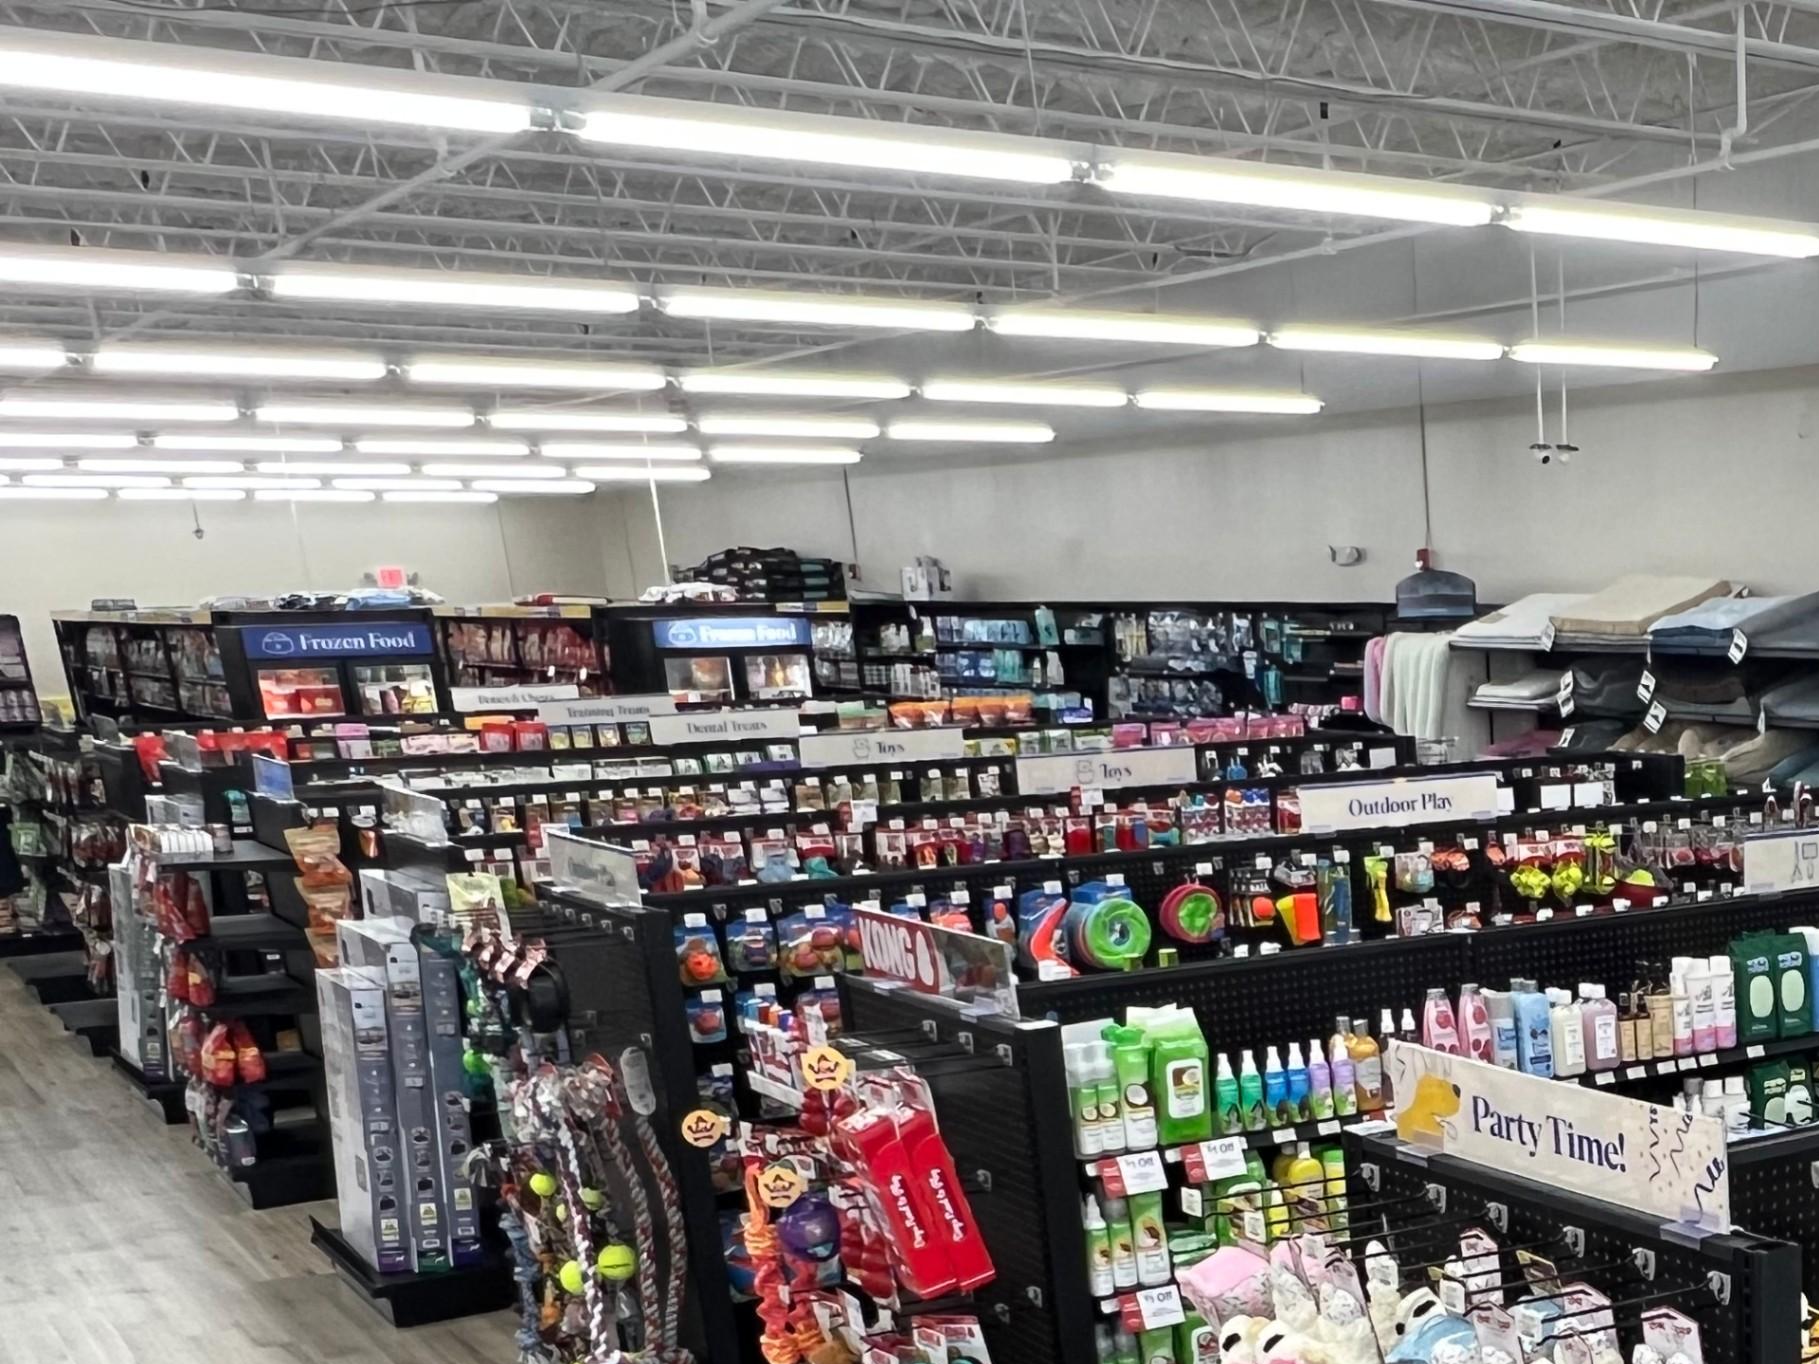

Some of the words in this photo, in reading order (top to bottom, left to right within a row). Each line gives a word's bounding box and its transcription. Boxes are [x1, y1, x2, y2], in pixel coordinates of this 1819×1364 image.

[300, 632, 365, 650] Frozen
[368, 631, 416, 649] Food
[567, 707, 614, 718] Training
[617, 704, 651, 715] Treats
[687, 720, 728, 733] Dental
[732, 720, 767, 731] Treats
[875, 740, 905, 756] Toys
[1100, 762, 1132, 780] Toys
[1348, 796, 1418, 816] Outdoor
[1421, 792, 1453, 813] Play
[858, 915, 917, 980] KONG
[1472, 1095, 1542, 1157] Party
[1546, 1114, 1627, 1173] Time!
[1157, 1290, 1173, 1303] Off
